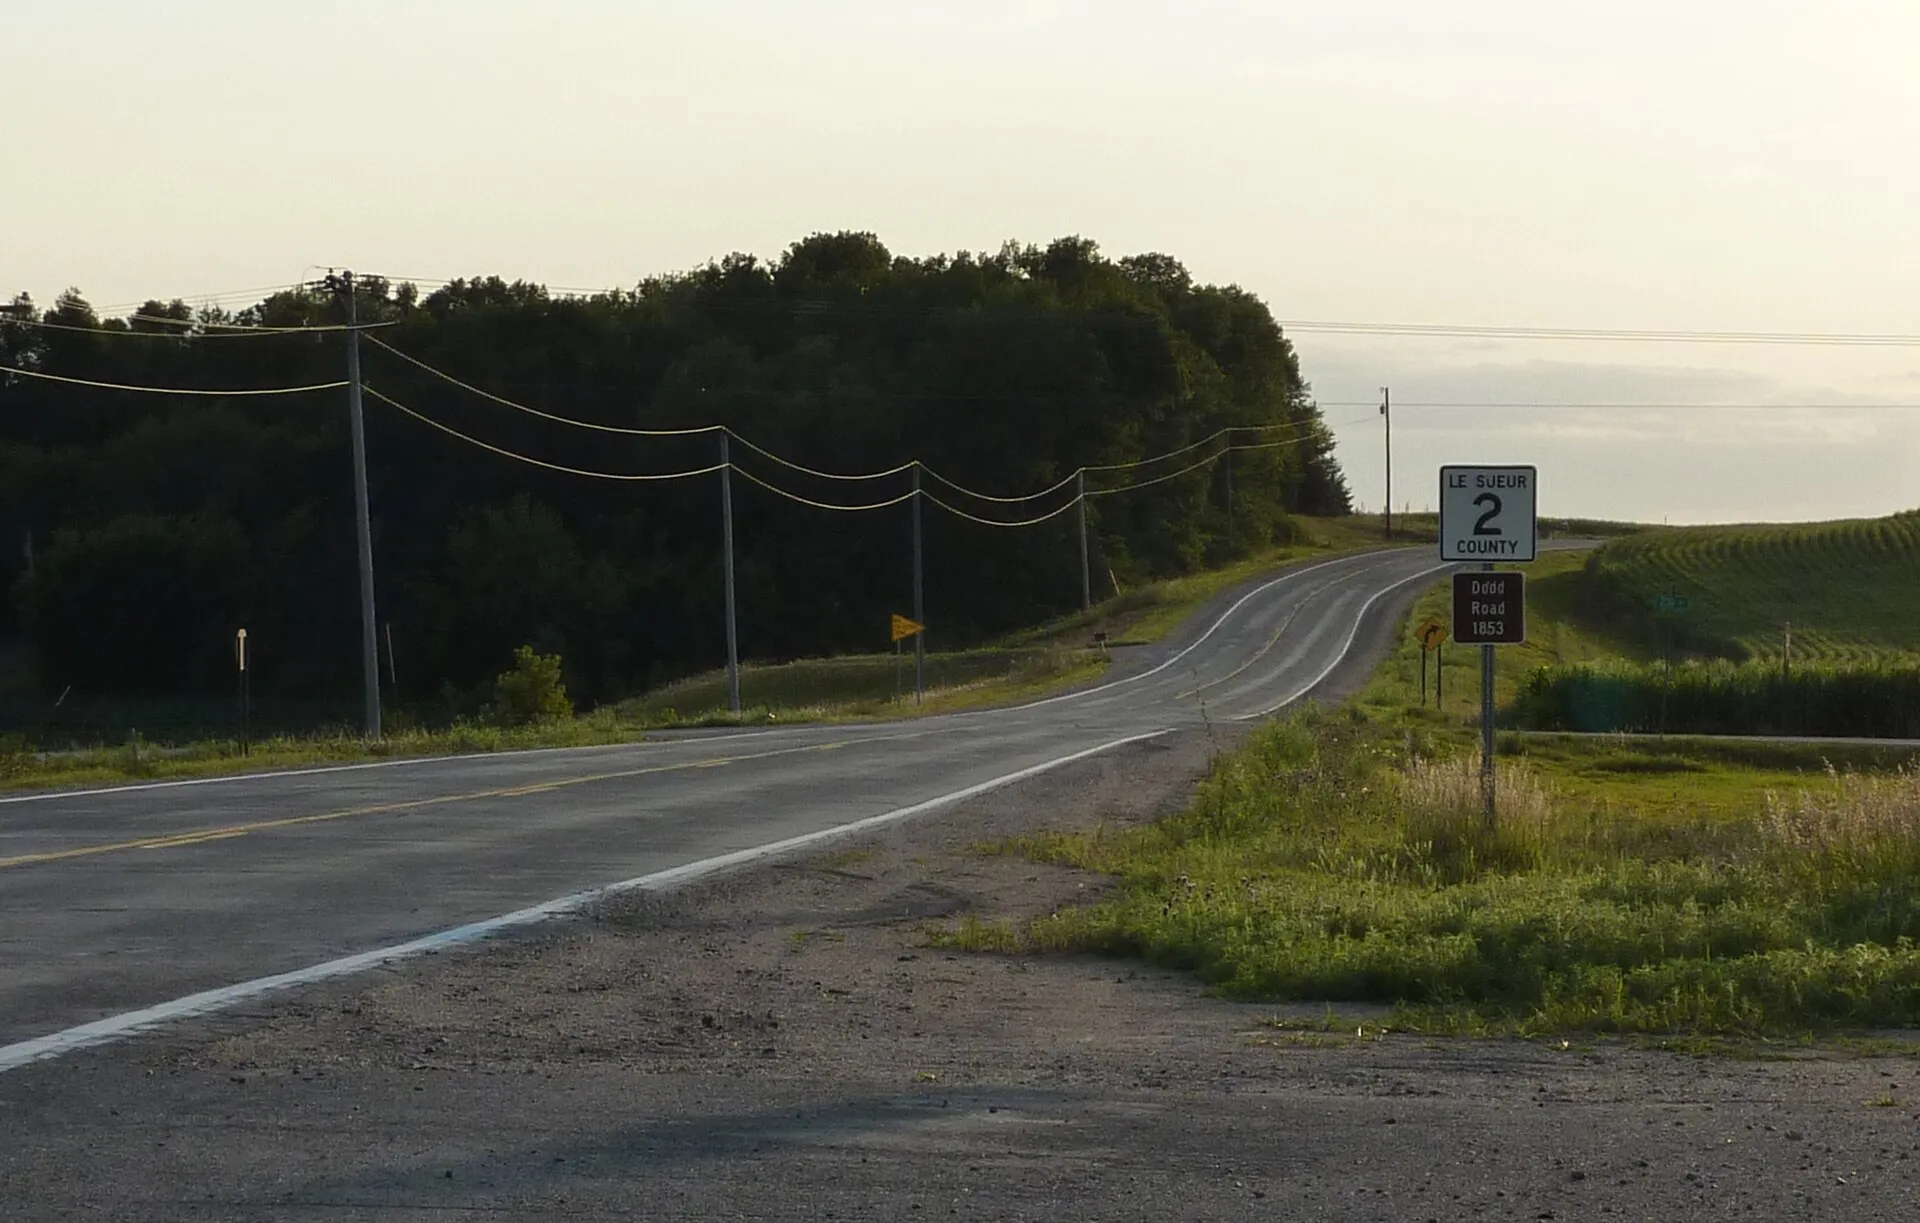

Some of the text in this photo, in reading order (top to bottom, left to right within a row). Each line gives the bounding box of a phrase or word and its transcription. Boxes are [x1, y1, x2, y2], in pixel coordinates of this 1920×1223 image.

[1449, 474, 1527, 488] LE SUEUR
[1473, 492, 1502, 535] 2
[1457, 540, 1518, 554] COUNTY
[1472, 580, 1505, 594] Dodd
[1472, 601, 1505, 615] Road
[1472, 621, 1504, 635] 1853
